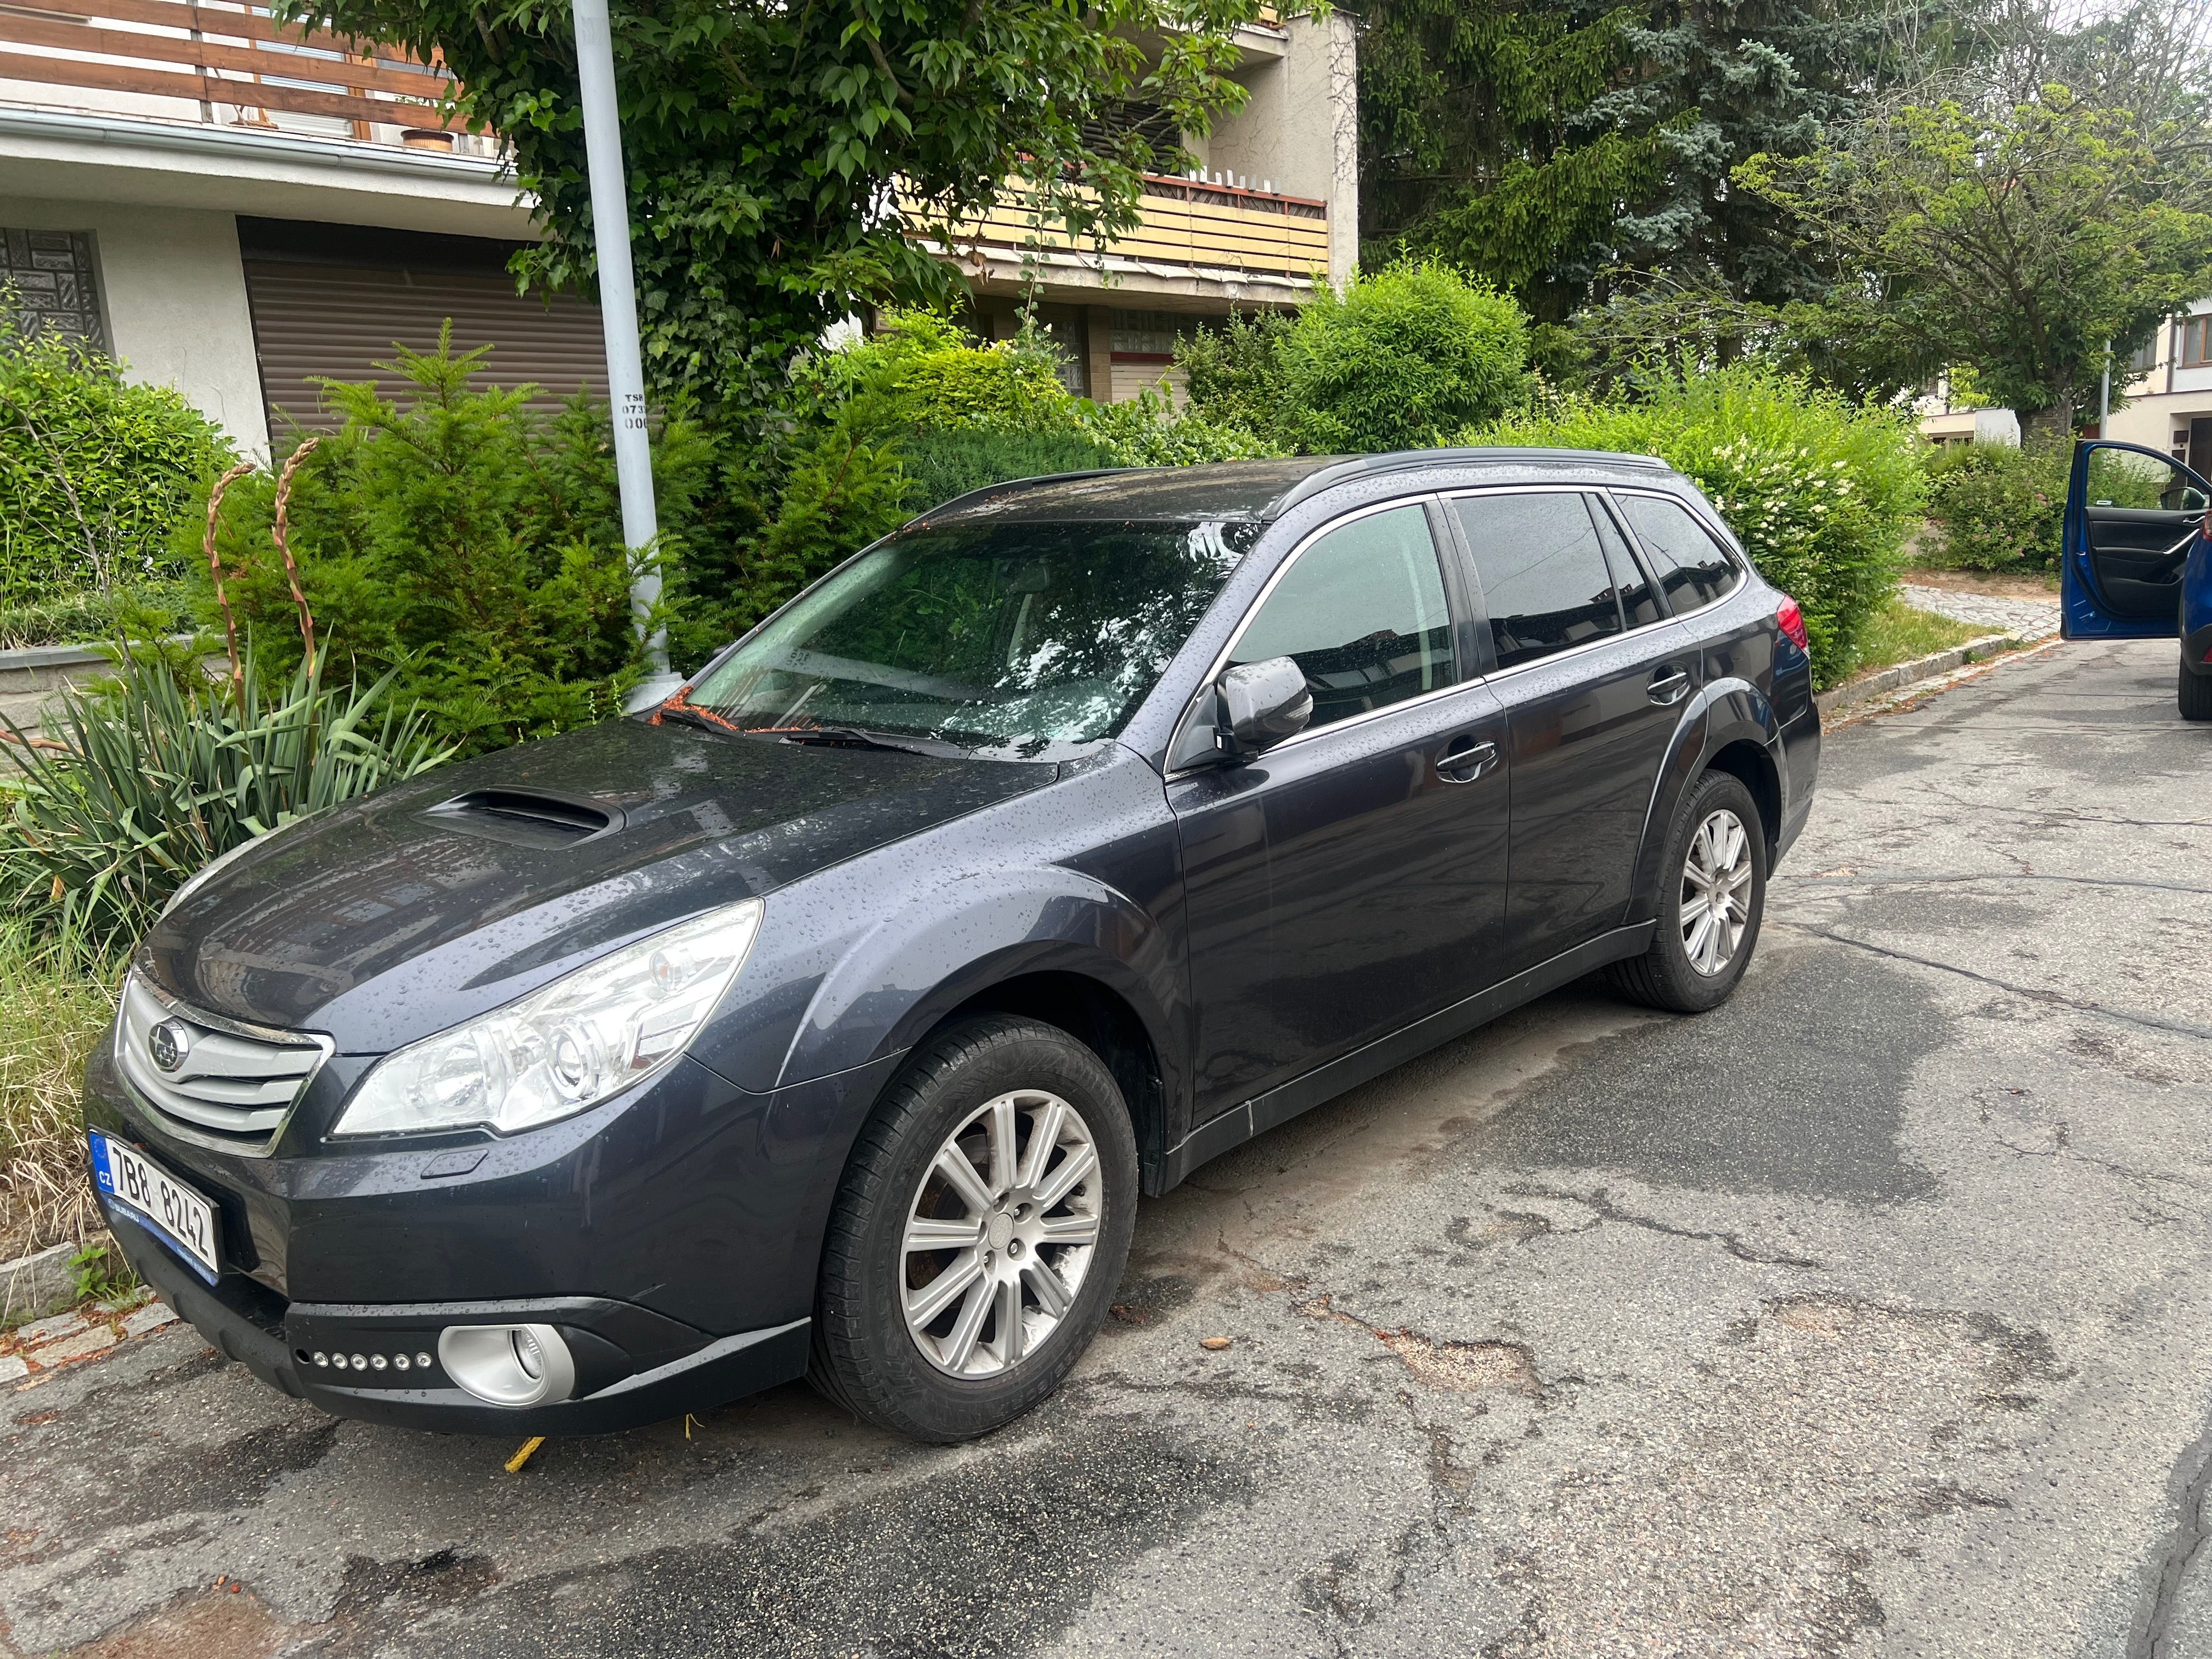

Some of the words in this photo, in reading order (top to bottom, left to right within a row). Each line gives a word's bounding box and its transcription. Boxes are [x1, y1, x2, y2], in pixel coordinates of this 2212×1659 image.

[622, 405, 646, 414] 073
[99, 1170, 112, 1186] CZ
[112, 1147, 151, 1208] 7B8
[160, 1180, 208, 1259] 8242
[115, 1206, 140, 1223] SUBARU
